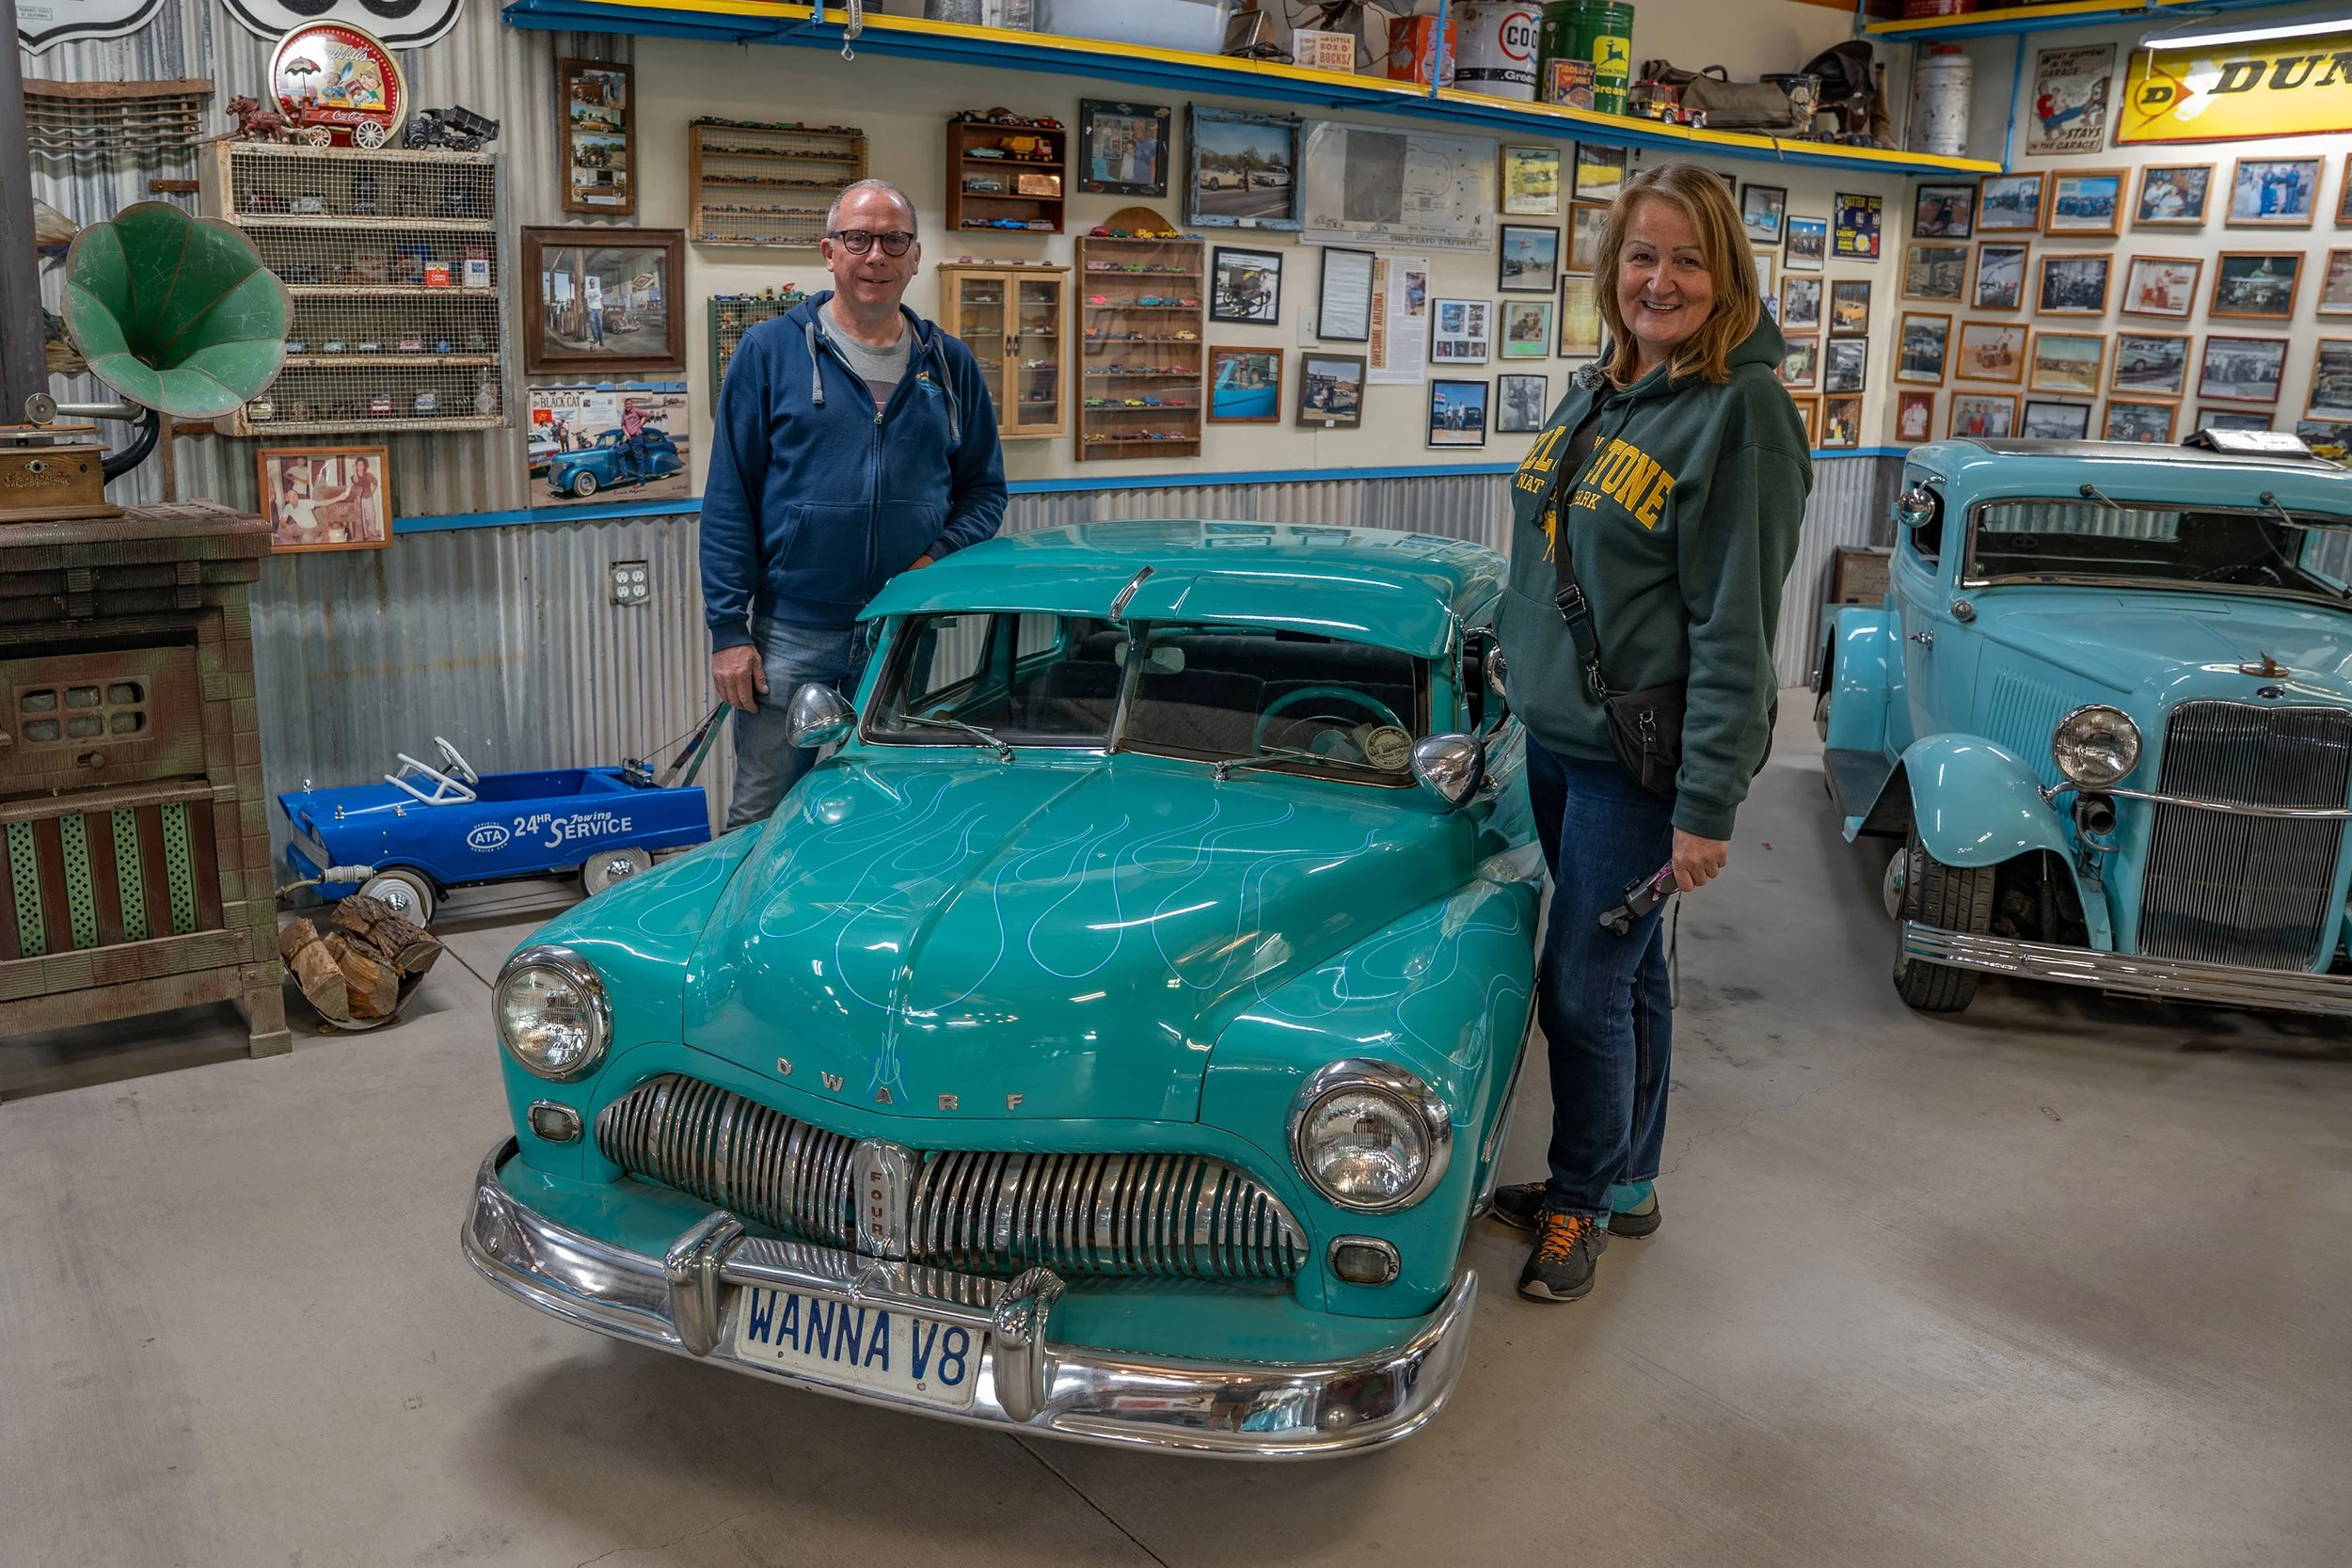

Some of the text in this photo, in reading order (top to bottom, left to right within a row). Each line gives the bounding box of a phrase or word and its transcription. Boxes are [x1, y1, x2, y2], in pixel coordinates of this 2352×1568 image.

[2066, 127, 2103, 139] STAYS
[2041, 141, 2054, 150] THE
[1370, 292, 1384, 368] AWESOME ARIZONA
[540, 396, 565, 408] BLACK
[566, 396, 580, 407] CAT
[570, 811, 612, 825] Towing
[475, 830, 502, 844] ATA
[545, 817, 633, 848] SERVICE
[776, 1056, 1024, 1111] DWARF
[870, 1171, 883, 1236] FOUR
[748, 1287, 970, 1386] WANNA V8
